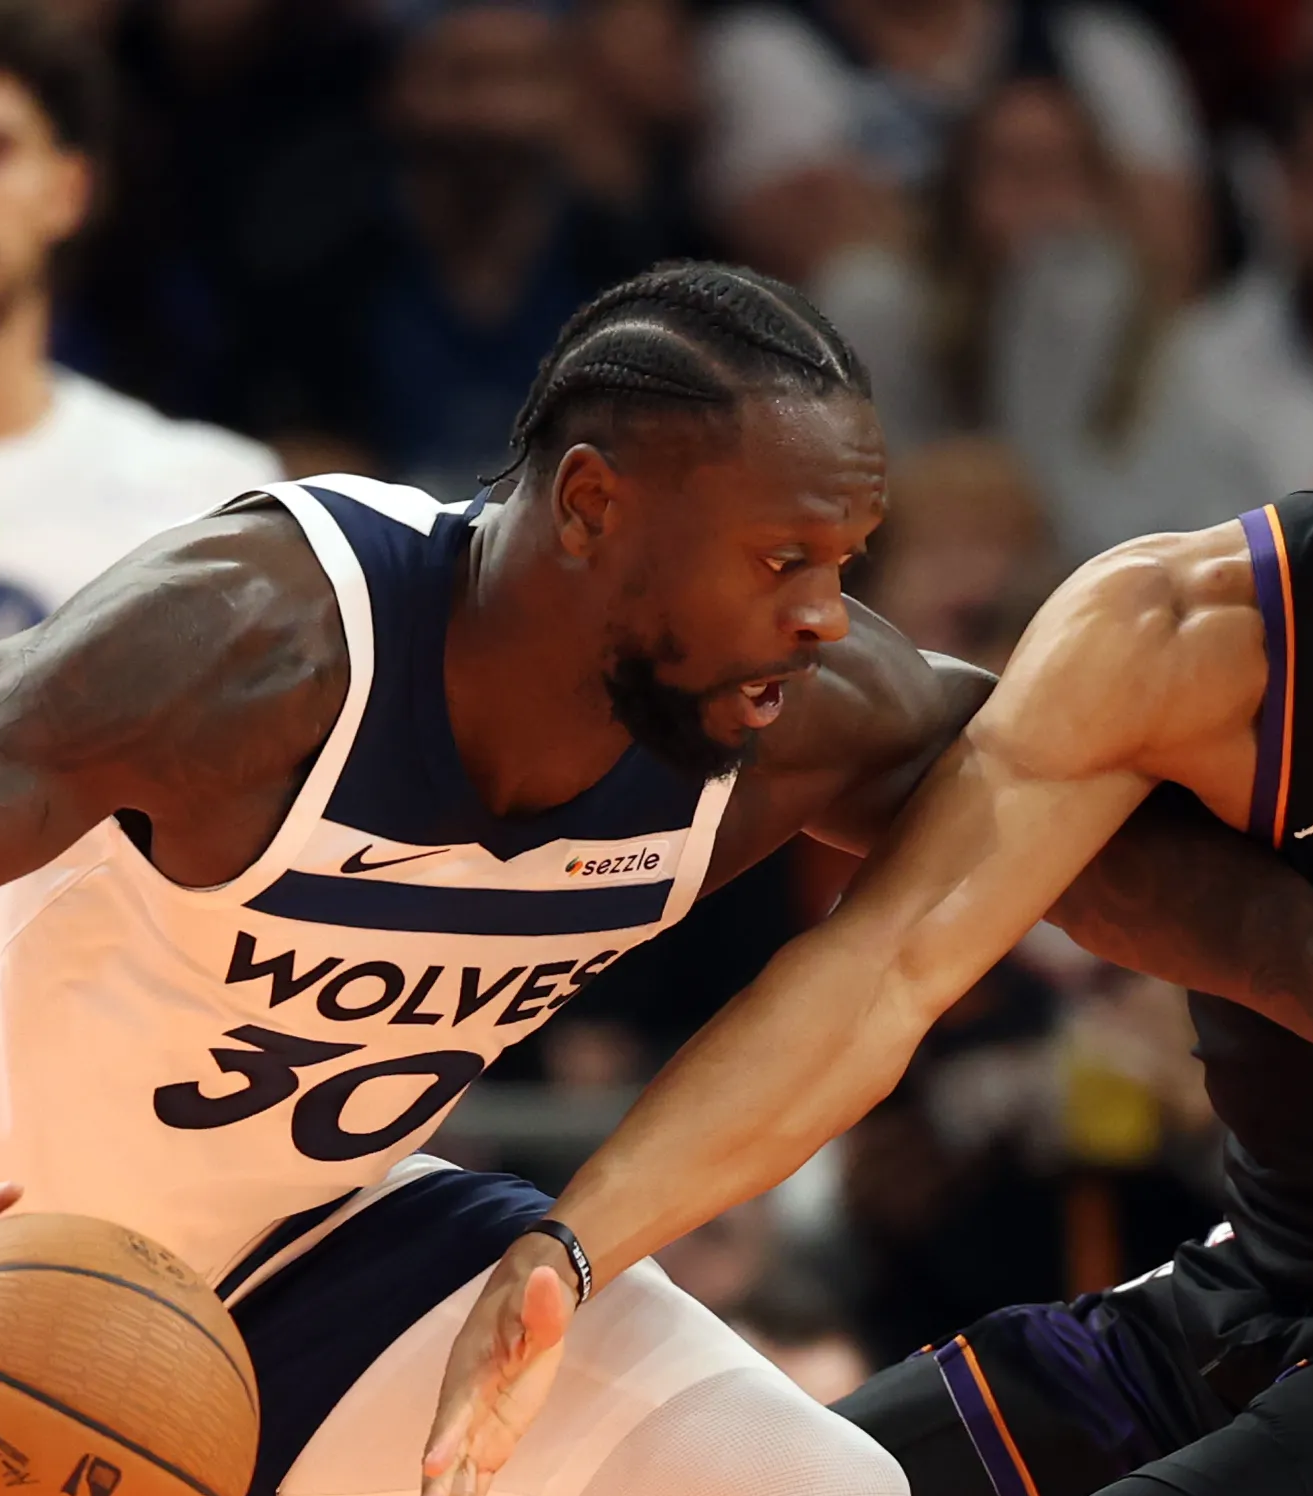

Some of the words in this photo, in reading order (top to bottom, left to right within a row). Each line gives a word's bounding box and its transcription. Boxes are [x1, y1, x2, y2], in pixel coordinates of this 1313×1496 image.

[581, 846, 661, 877] sezzle
[224, 930, 619, 1028] WOLVES
[153, 1023, 485, 1162] 30
